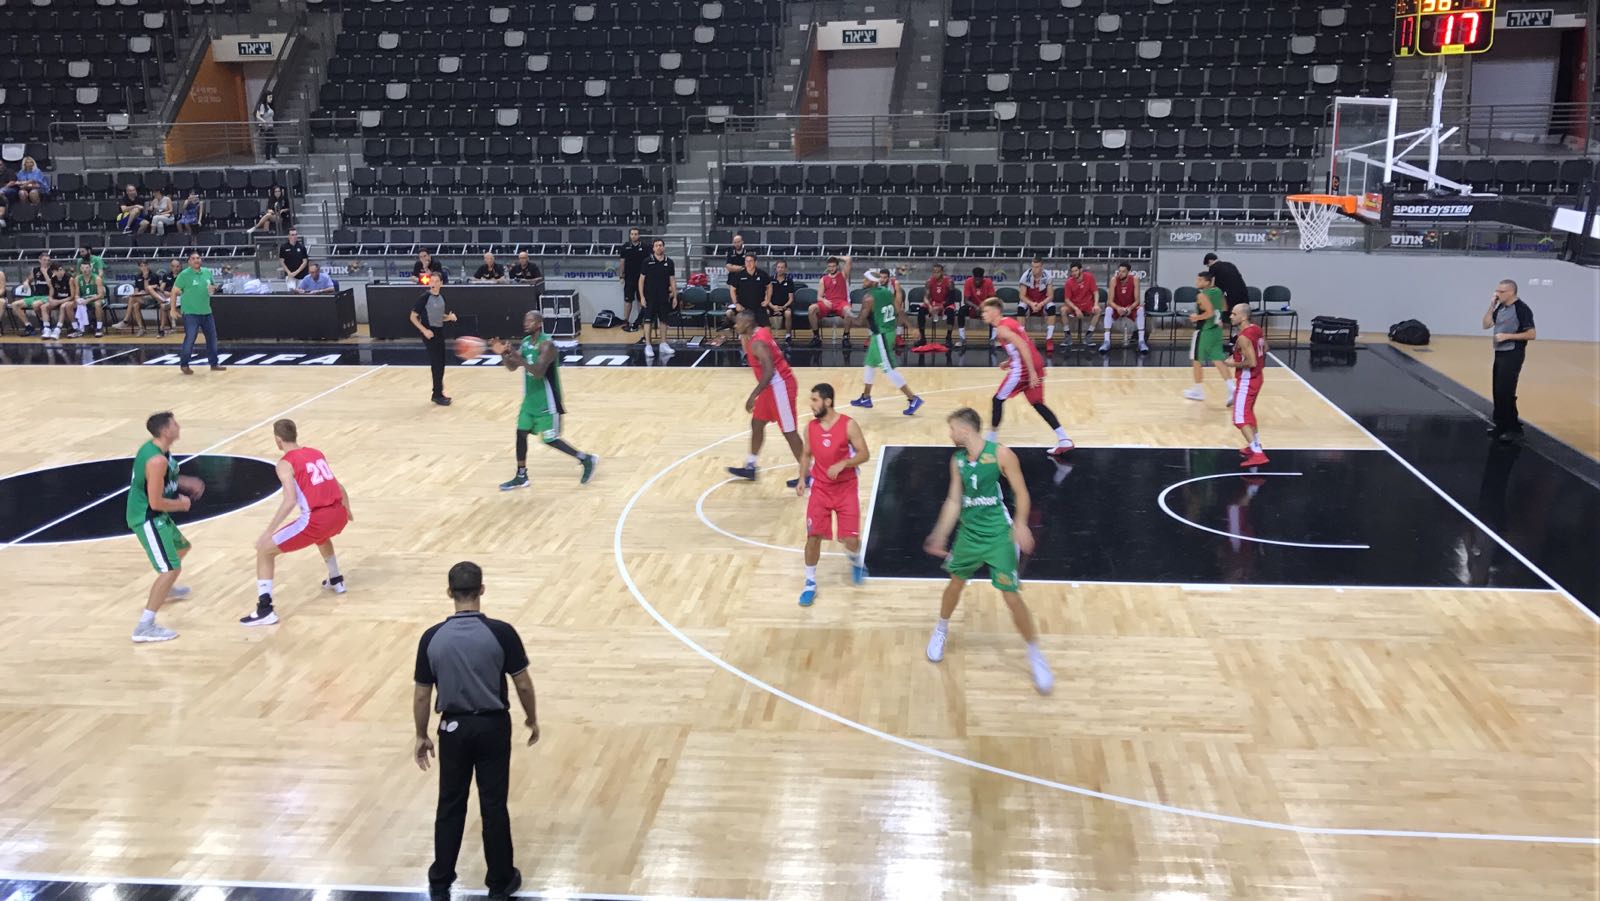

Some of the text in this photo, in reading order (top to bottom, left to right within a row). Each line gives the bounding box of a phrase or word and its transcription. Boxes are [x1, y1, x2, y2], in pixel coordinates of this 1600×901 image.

[1444, 12, 1480, 44] 17
[1510, 12, 1550, 26] יציאה
[845, 30, 875, 43] יציאה
[240, 43, 270, 55] יציאה
[881, 304, 897, 323] 22
[306, 459, 333, 486] 20
[969, 473, 978, 491] 1
